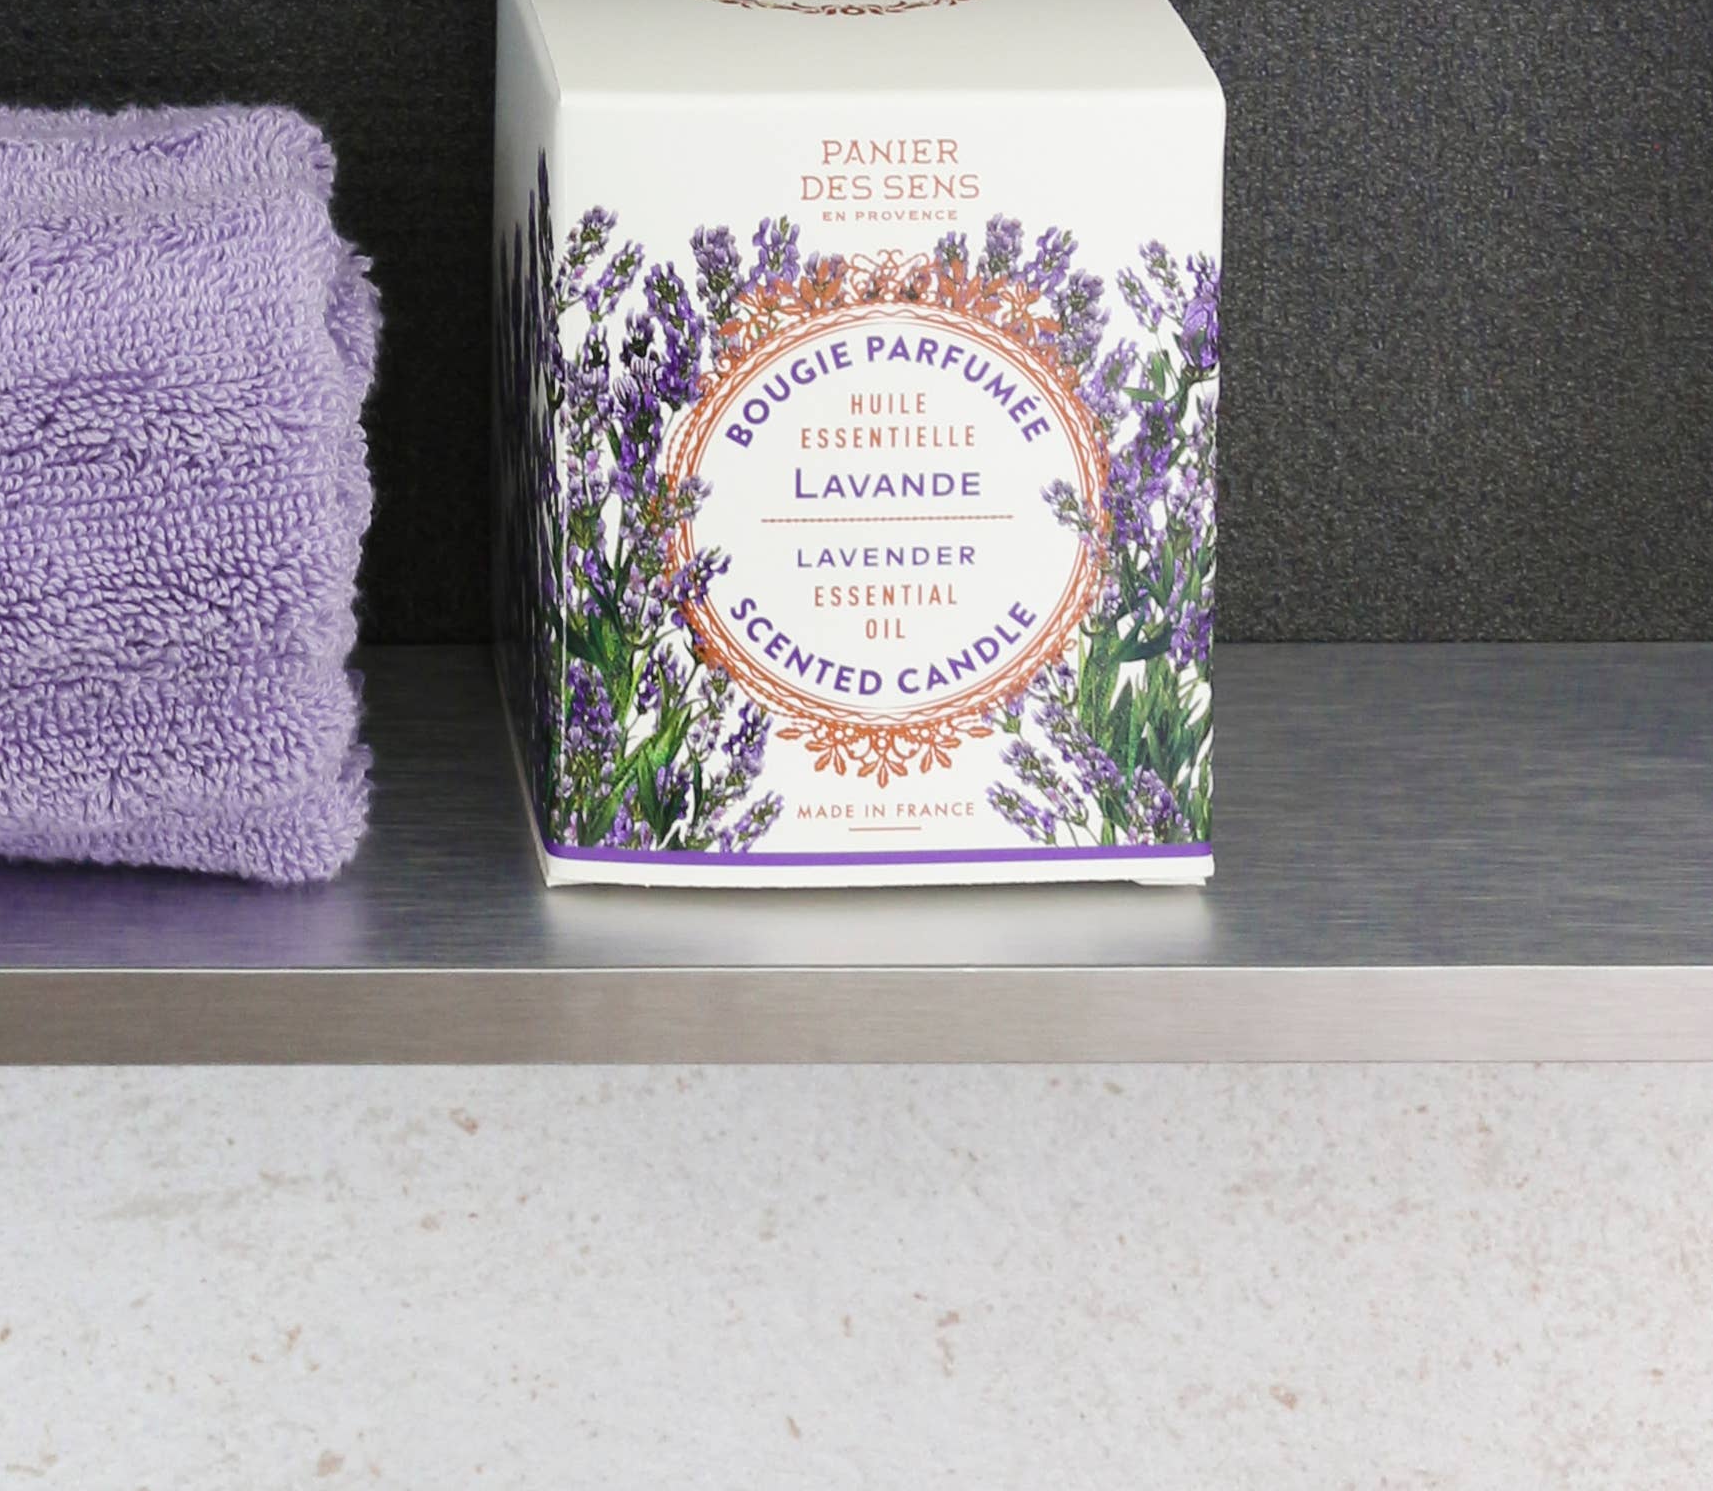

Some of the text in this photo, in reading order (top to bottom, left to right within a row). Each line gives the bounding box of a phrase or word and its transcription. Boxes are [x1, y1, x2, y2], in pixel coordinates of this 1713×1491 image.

[822, 139, 958, 165] PANIER
[800, 174, 979, 200] DES SENS
[823, 210, 958, 221] EN PROVENCE
[724, 335, 1051, 448] BOUGIE PARFUMÉE
[851, 393, 926, 415] HUILE
[801, 425, 975, 449] ESSENTIELLE
[797, 546, 976, 568] LAVENDER
[814, 584, 957, 607] ESSENTIAL
[865, 618, 905, 639] OIL
[730, 597, 1037, 696] SCENTED CANDLE
[797, 802, 974, 819] MADE IN FRANCE
